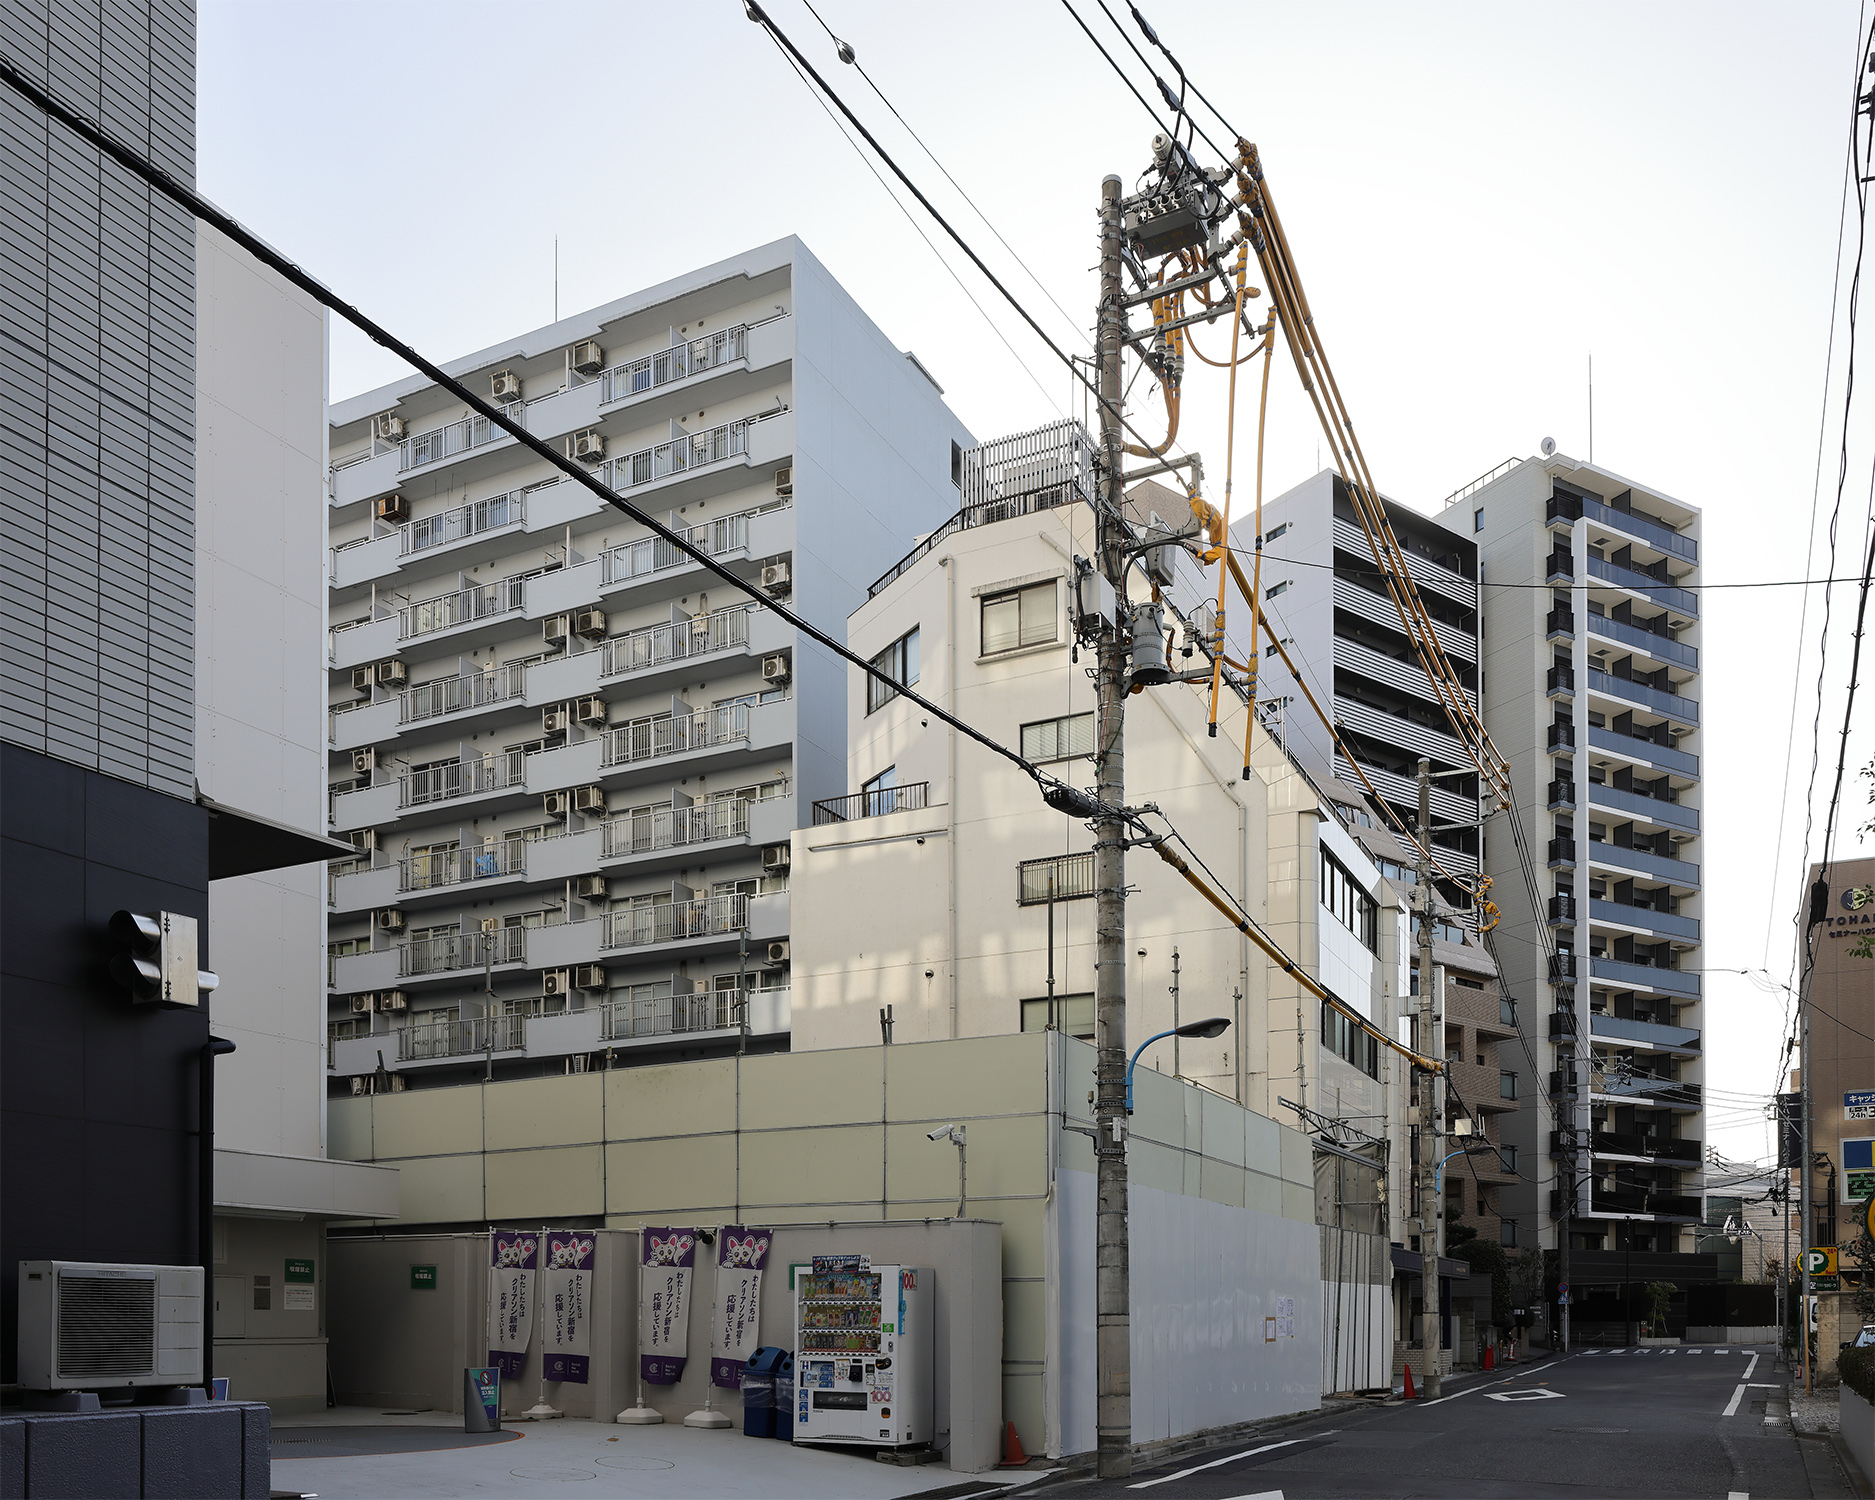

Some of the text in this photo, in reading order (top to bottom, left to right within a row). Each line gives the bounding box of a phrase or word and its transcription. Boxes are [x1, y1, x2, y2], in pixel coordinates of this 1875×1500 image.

[1826, 913, 1875, 926] TOHA
[1809, 1253, 1825, 1271] P
[508, 1277, 518, 1340] クリアソン新宿を
[567, 1279, 576, 1342] クリアソン新宿を
[575, 1274, 583, 1319] わたしたちは
[663, 1277, 674, 1342] クリアソン新宿を
[674, 1272, 684, 1319] わたしたちは
[736, 1279, 748, 1346] クリアソン新宿を
[747, 1275, 759, 1323] わたしたちは
[871, 1391, 892, 1402] 100
